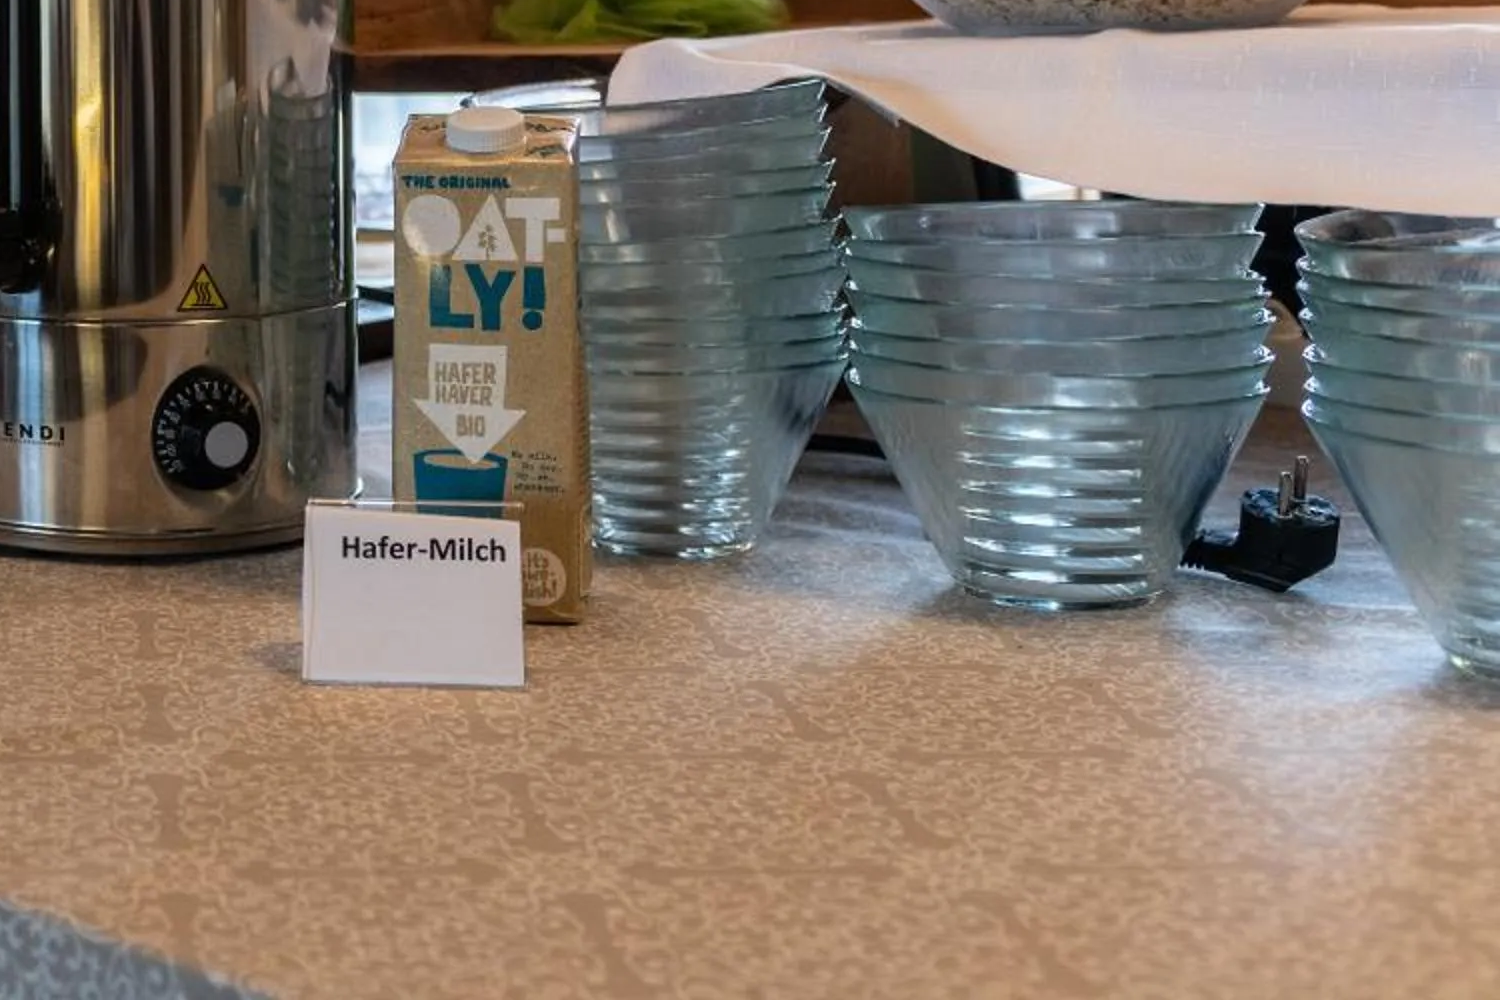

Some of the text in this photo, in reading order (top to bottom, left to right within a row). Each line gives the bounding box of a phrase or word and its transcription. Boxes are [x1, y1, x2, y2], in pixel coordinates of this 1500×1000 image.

[401, 175, 511, 190] THE ORIGINAL
[428, 263, 546, 332] LY!
[434, 361, 497, 385] HAFER
[434, 383, 493, 407] HAVER
[455, 412, 486, 438] BIO
[341, 535, 507, 563] Hafer-Milch
